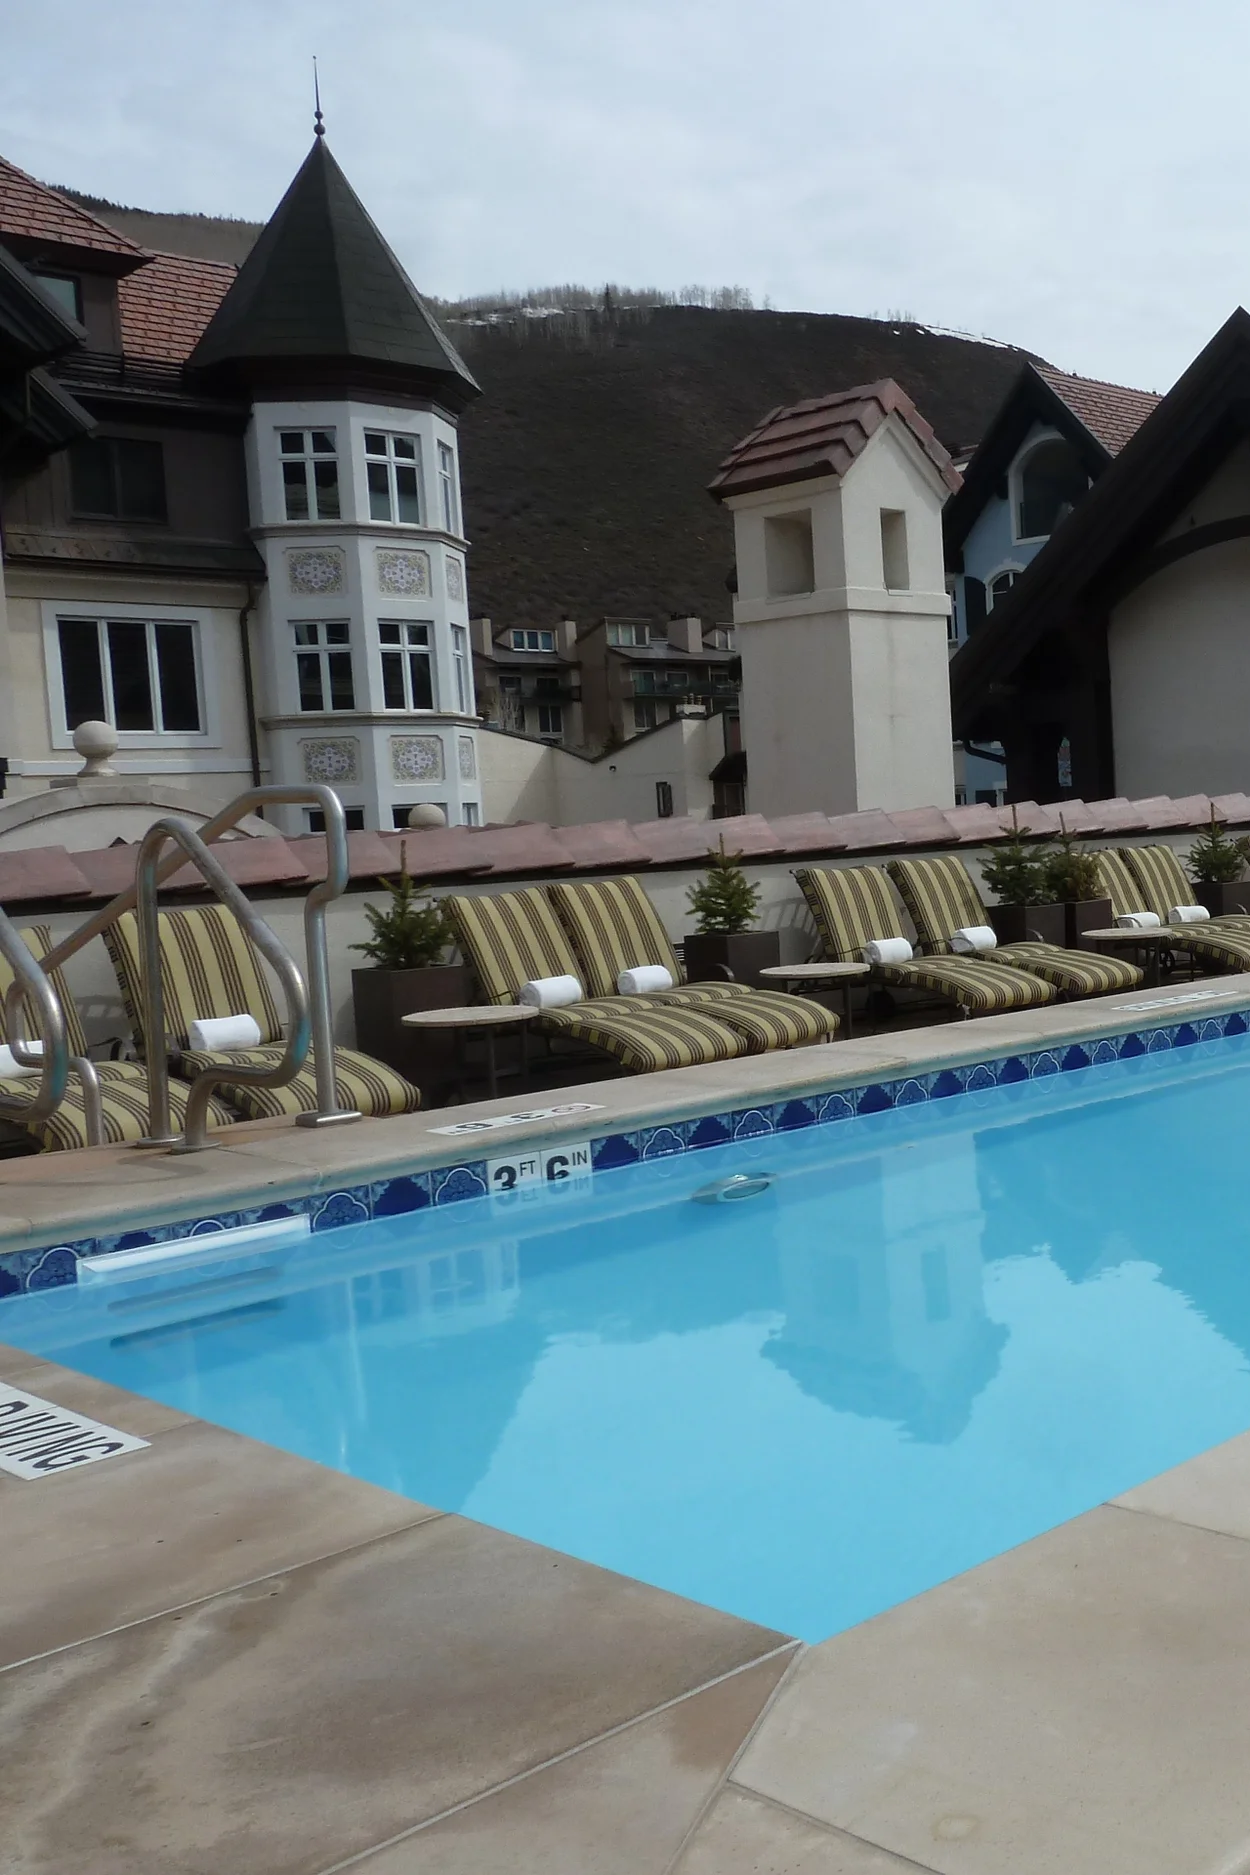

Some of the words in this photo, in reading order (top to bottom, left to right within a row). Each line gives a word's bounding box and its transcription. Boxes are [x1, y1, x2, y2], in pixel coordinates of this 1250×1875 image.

[493, 1164, 518, 1192] 3
[519, 1159, 536, 1175] FT
[546, 1155, 570, 1182] 6
[572, 1149, 588, 1167] IN
